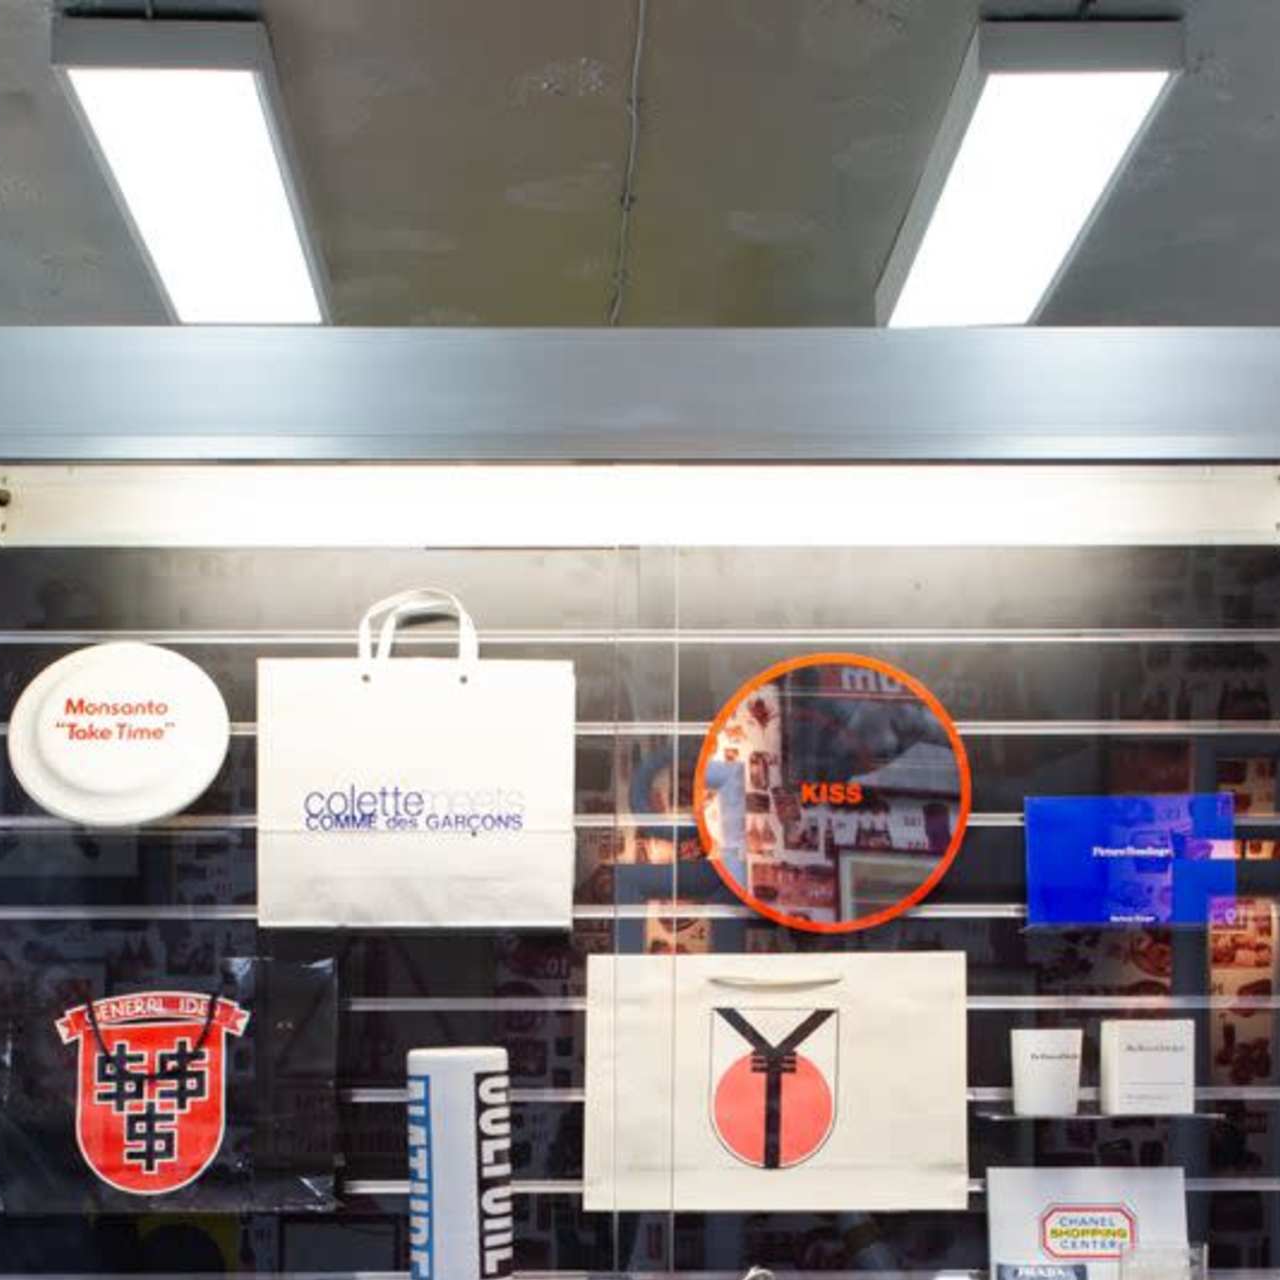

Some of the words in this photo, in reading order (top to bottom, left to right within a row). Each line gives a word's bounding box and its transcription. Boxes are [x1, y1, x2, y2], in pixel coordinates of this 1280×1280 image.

[64, 698, 169, 716] Monsanto
[304, 784, 425, 818] colette
[801, 783, 863, 804] KISS
[305, 814, 376, 831] COMME
[385, 815, 419, 830] des
[425, 814, 523, 837] GARÇONS
[1059, 1217, 1115, 1228] CHANEL
[1050, 1227, 1127, 1239] SHOPPING
